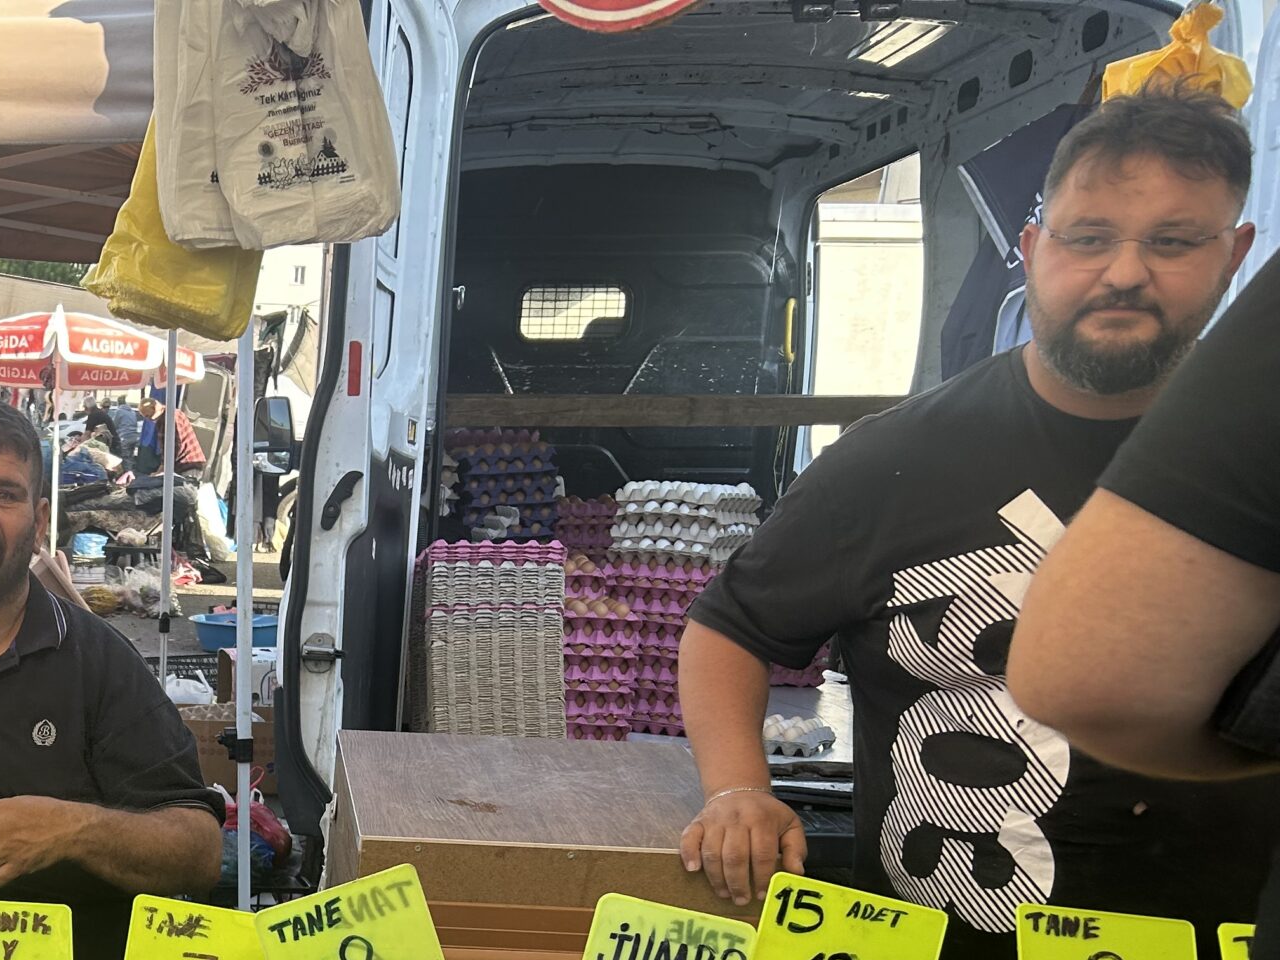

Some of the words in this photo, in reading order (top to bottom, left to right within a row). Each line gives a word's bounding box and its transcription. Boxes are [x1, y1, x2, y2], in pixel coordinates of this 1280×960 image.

[268, 897, 344, 943] TANE
[774, 888, 825, 935] 15
[846, 900, 908, 928] ADET
[1025, 911, 1101, 940] TANE
